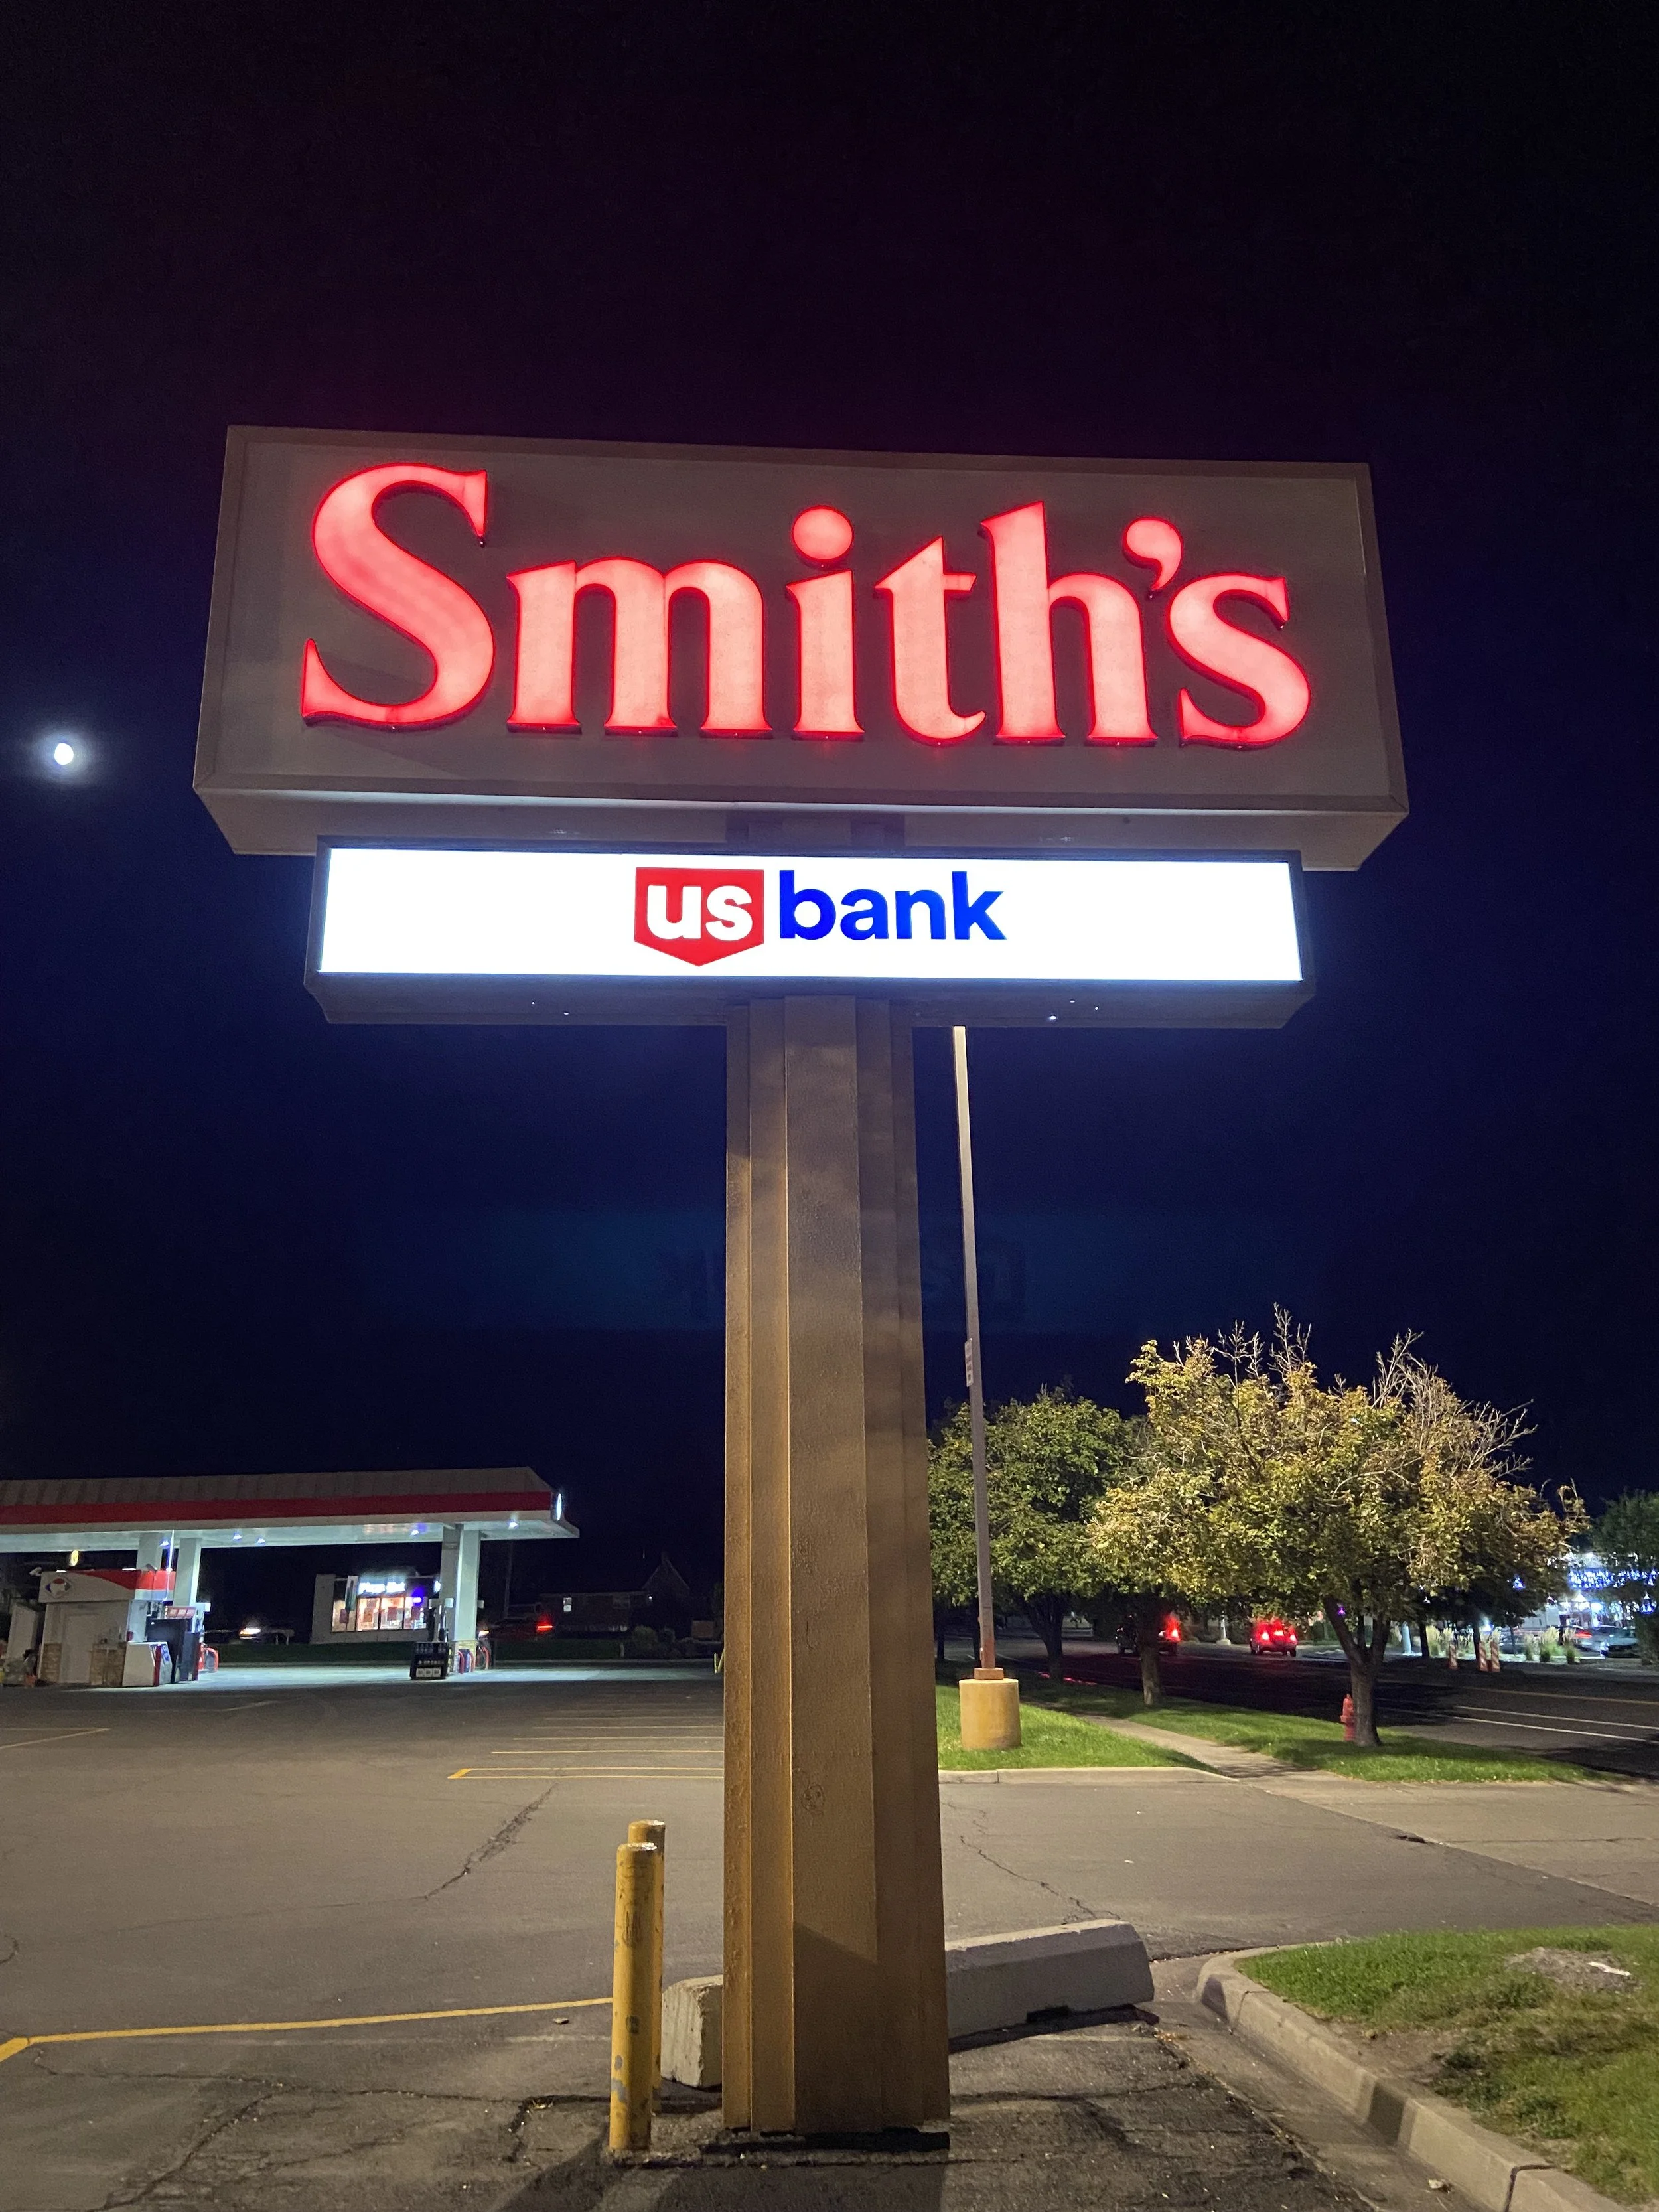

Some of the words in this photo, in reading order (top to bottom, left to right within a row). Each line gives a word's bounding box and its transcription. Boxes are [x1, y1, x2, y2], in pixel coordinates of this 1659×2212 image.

[301, 463, 1310, 750] Smith's
[646, 885, 754, 942] us
[779, 869, 1006, 941] bank
